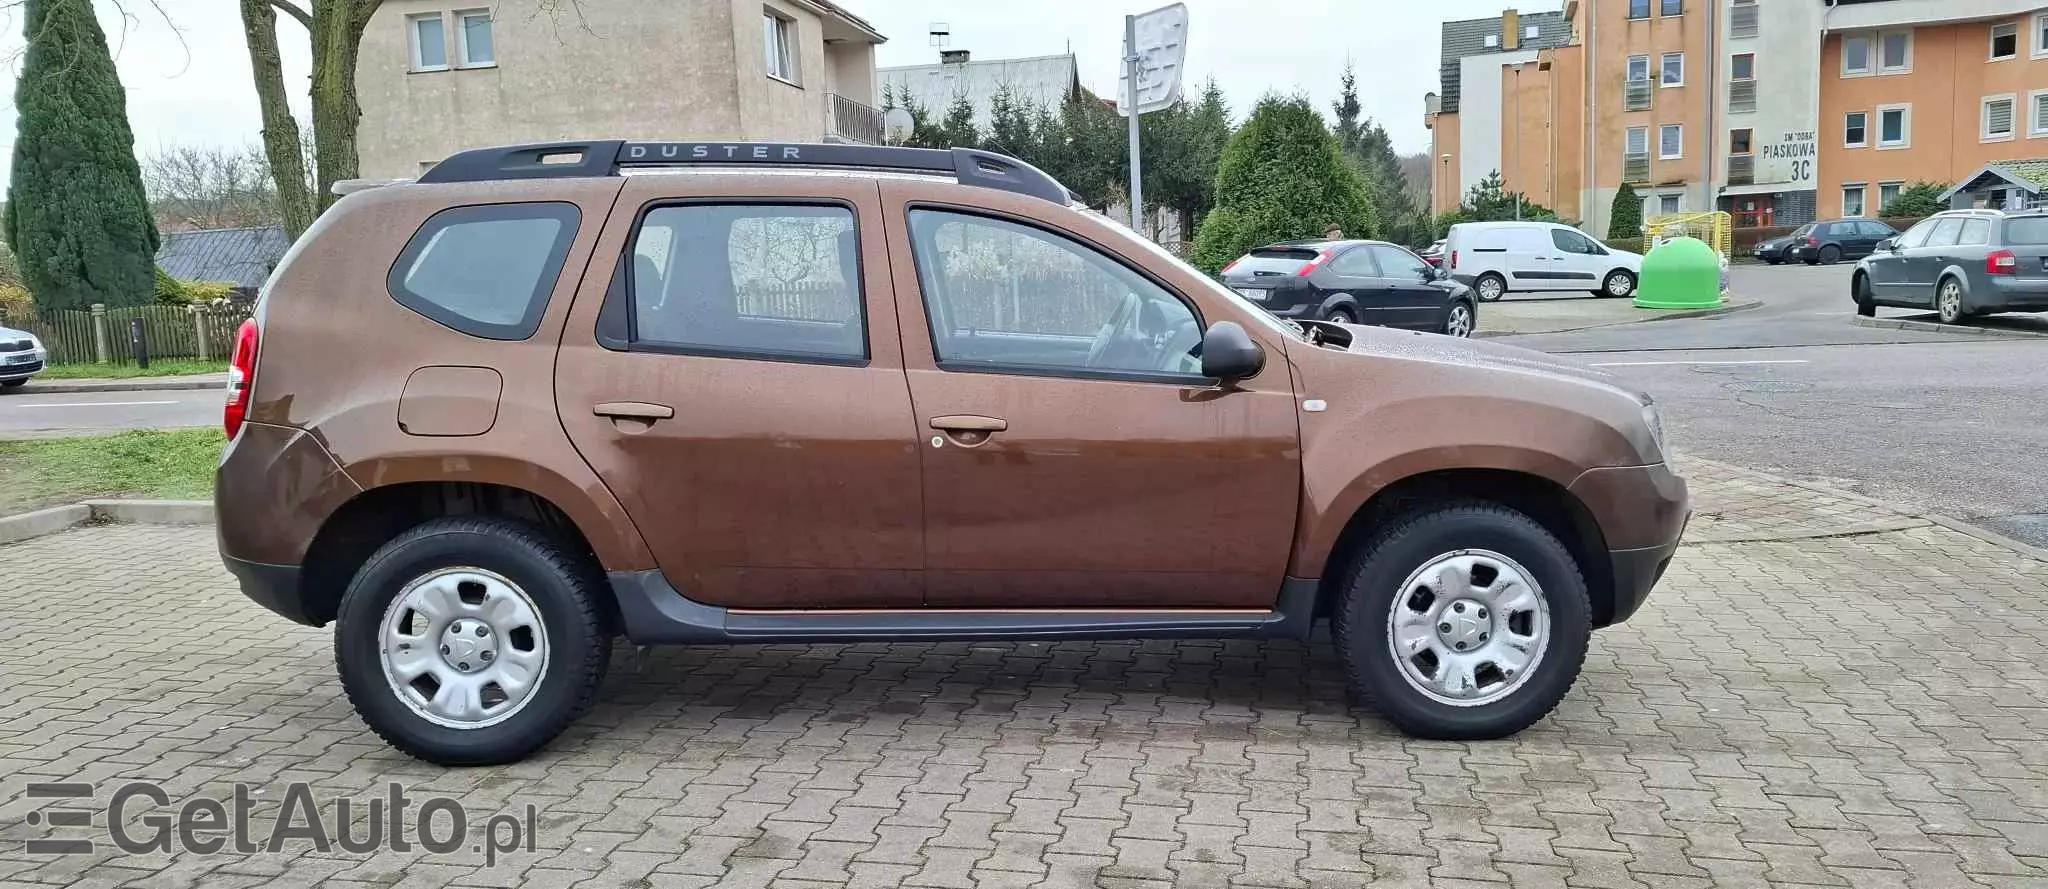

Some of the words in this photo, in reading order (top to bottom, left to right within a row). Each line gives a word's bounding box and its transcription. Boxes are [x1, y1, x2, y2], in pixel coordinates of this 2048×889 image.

[631, 146, 801, 158] DUSTER
[1763, 143, 1815, 159] PIASKOWA
[1792, 160, 1810, 181] 3C
